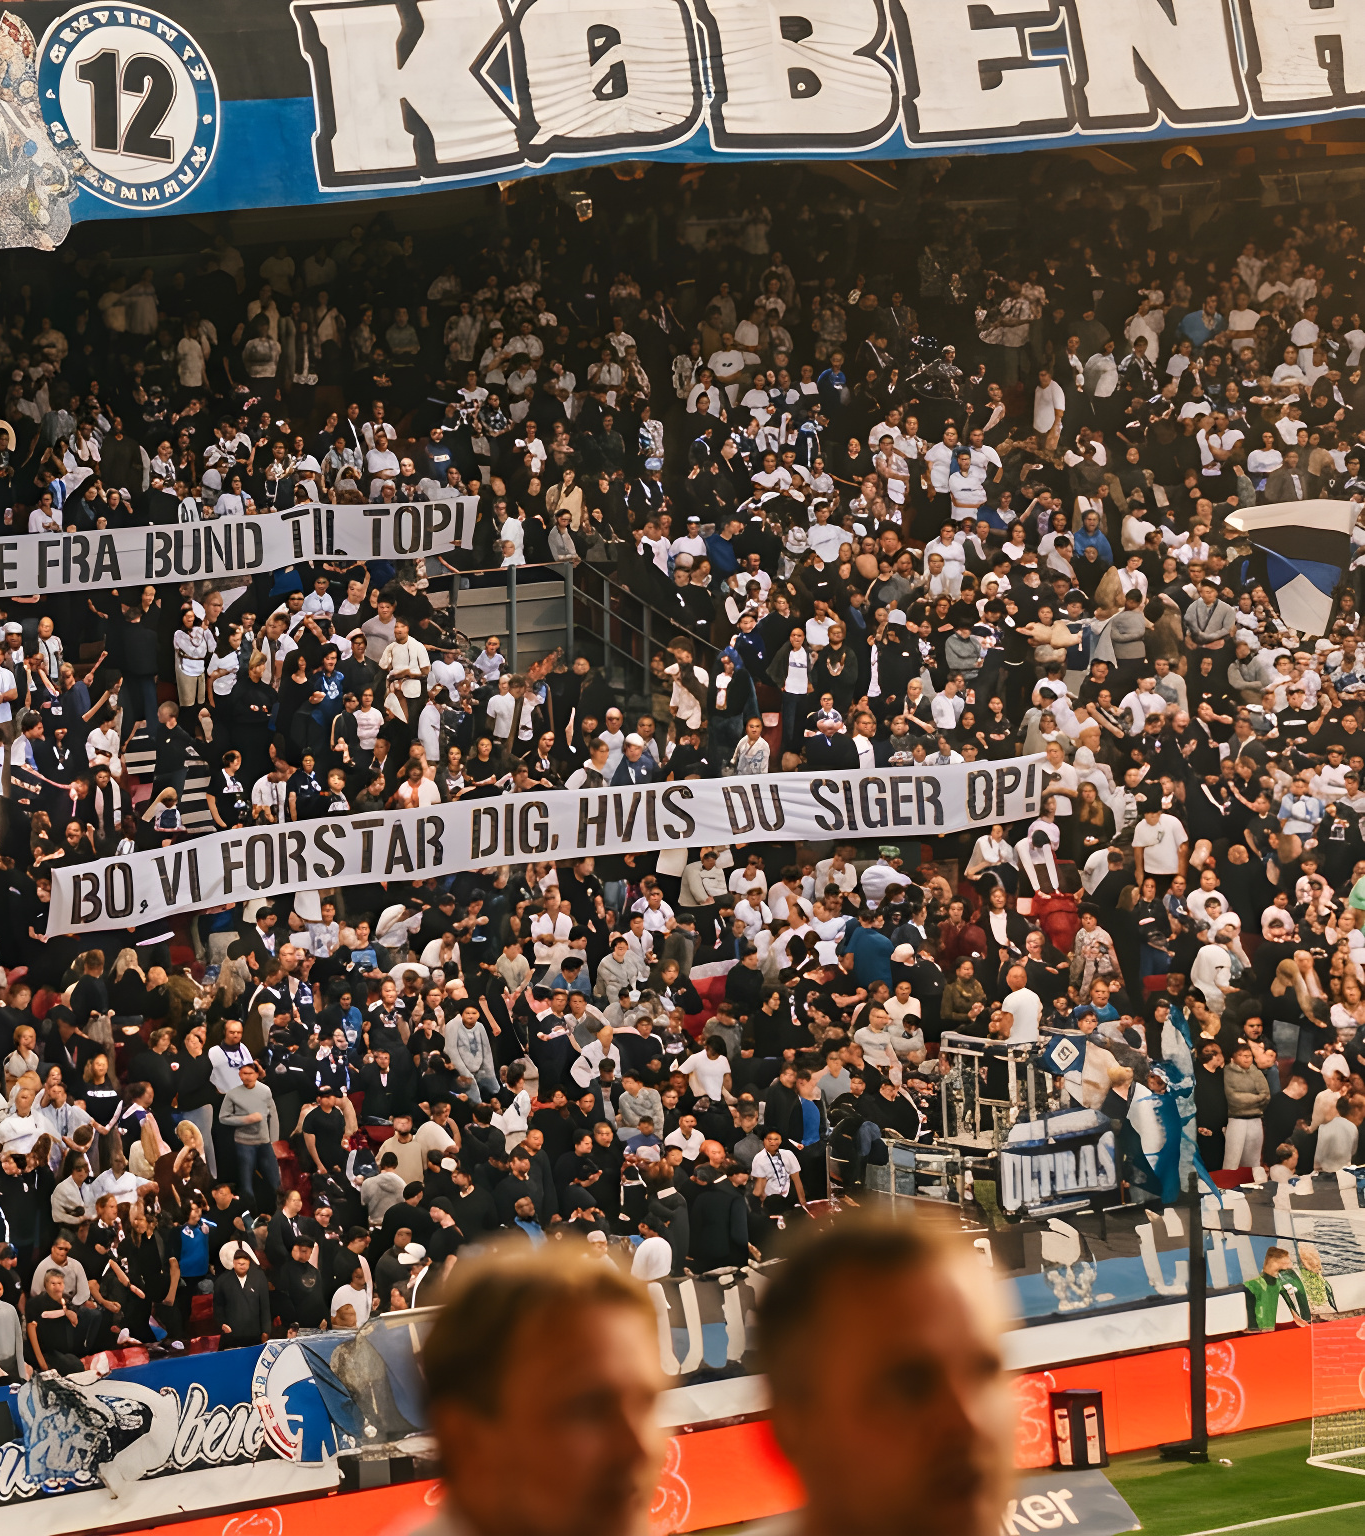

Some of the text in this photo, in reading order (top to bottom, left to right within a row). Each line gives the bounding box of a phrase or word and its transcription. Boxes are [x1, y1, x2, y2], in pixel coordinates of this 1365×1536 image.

[76, 48, 177, 163] 12
[37, 534, 122, 589] FRA
[144, 521, 264, 579] BUND
[280, 507, 348, 559] TIL
[151, 848, 202, 906] VI
[576, 785, 696, 849] HVIS
[721, 783, 786, 836] DU
[809, 775, 945, 832] SIGER
[966, 763, 1037, 821] OP!
